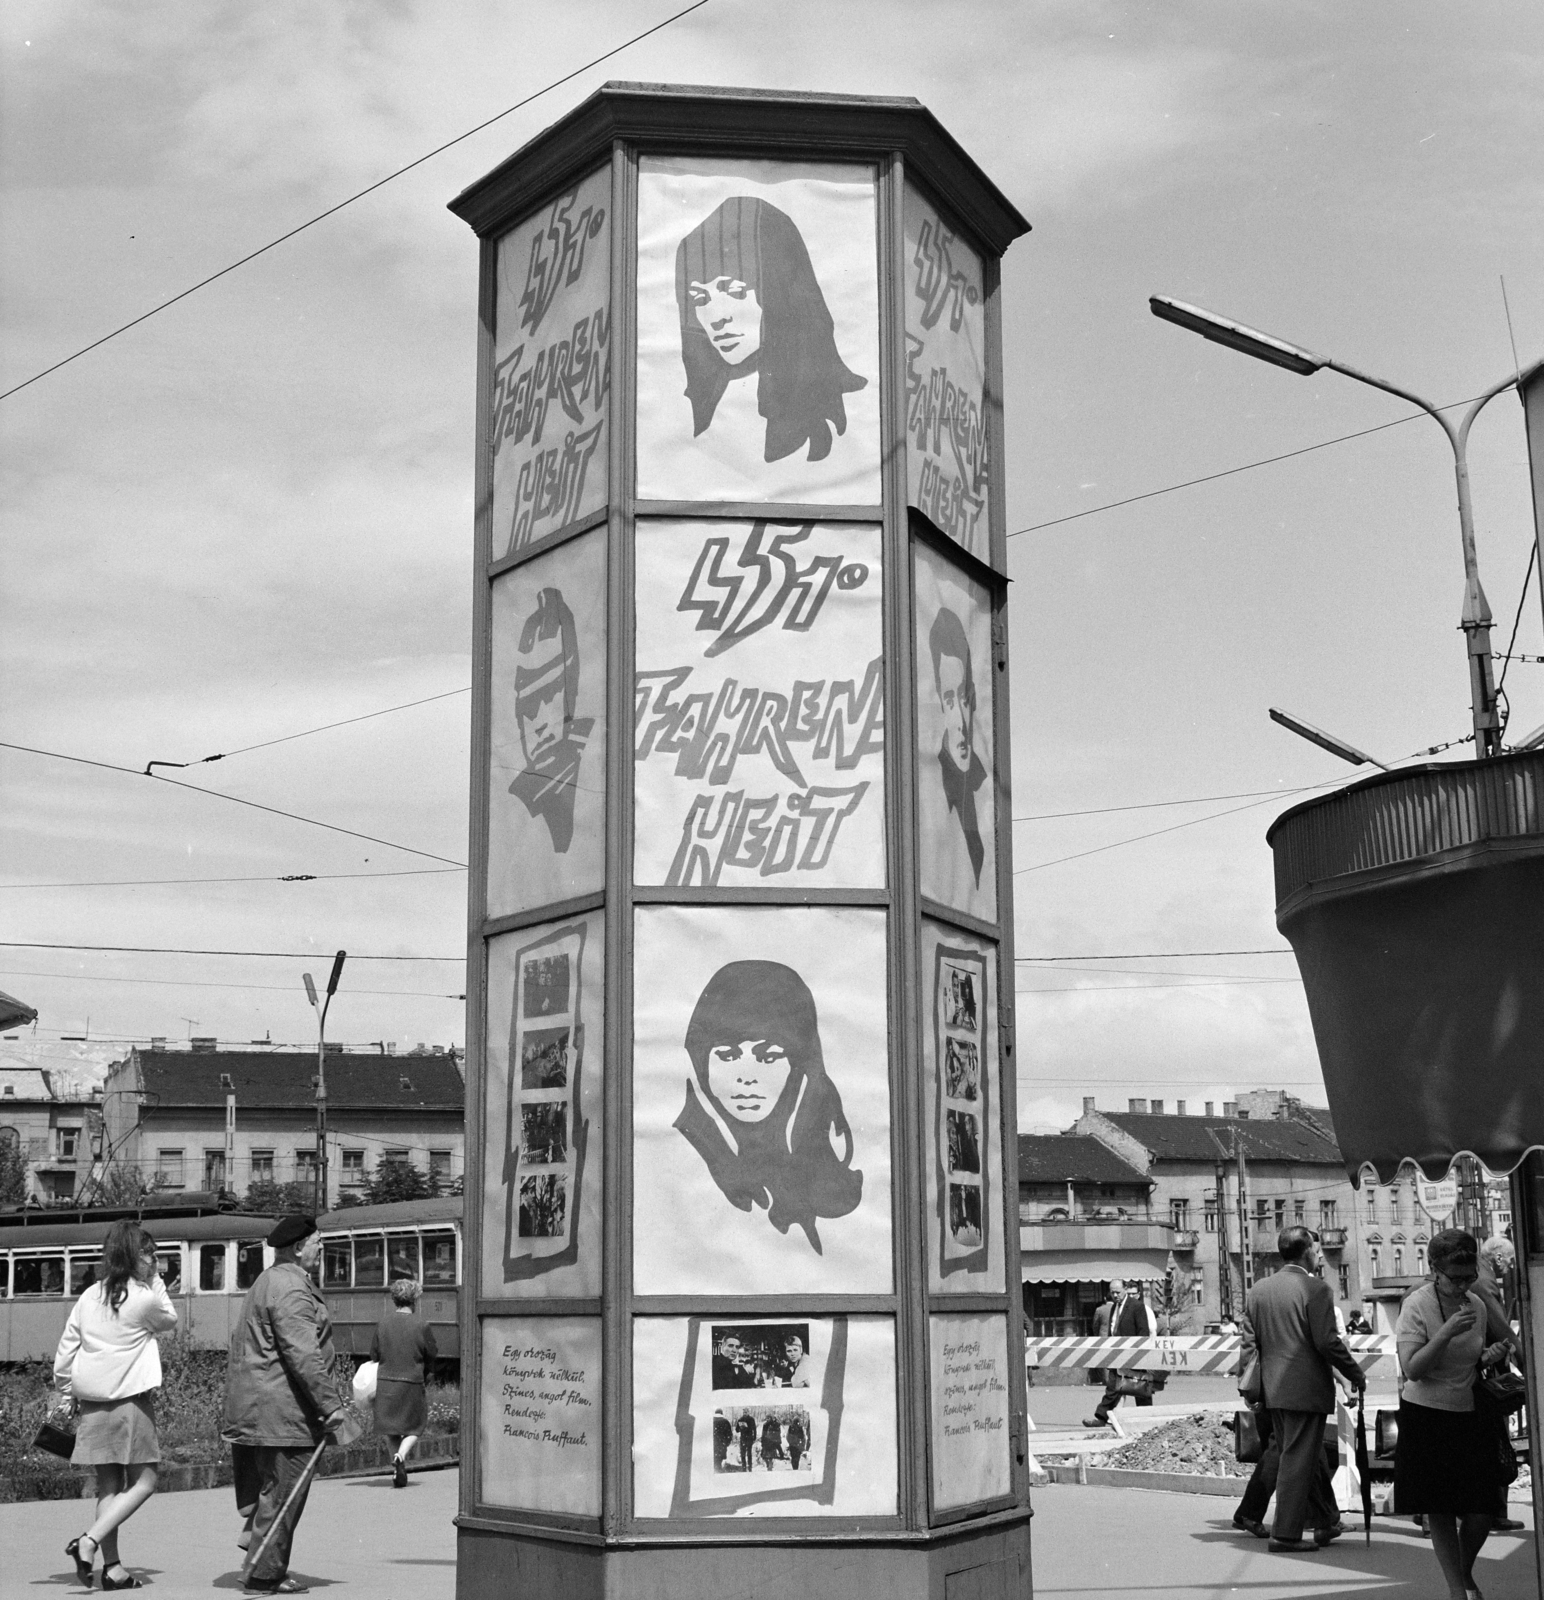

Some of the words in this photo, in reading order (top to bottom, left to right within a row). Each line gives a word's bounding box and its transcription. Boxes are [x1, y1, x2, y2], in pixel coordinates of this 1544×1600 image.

[502, 1345, 522, 1361] Egy
[524, 1347, 557, 1364] ország
[502, 1365, 546, 1382] könyvek
[538, 1389, 567, 1405] angol
